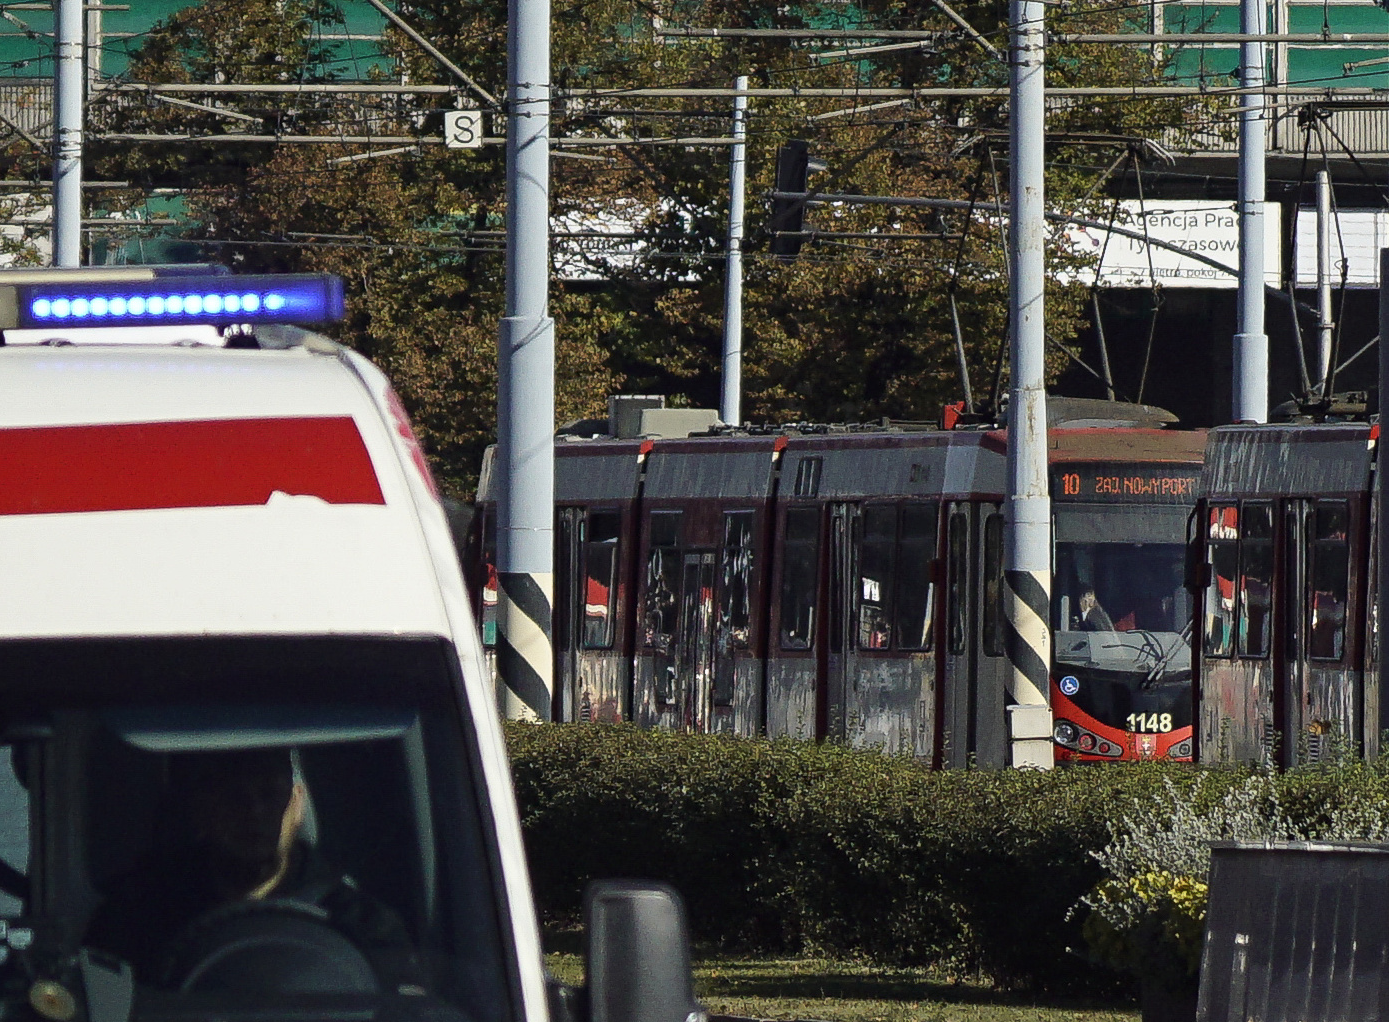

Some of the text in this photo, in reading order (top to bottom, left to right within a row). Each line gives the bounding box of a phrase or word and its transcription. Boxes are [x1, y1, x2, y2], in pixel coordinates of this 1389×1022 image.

[454, 115, 474, 143] S
[1123, 209, 1240, 231] Agencja Pra
[1062, 473, 1080, 495] 10
[1126, 712, 1172, 733] 1148
